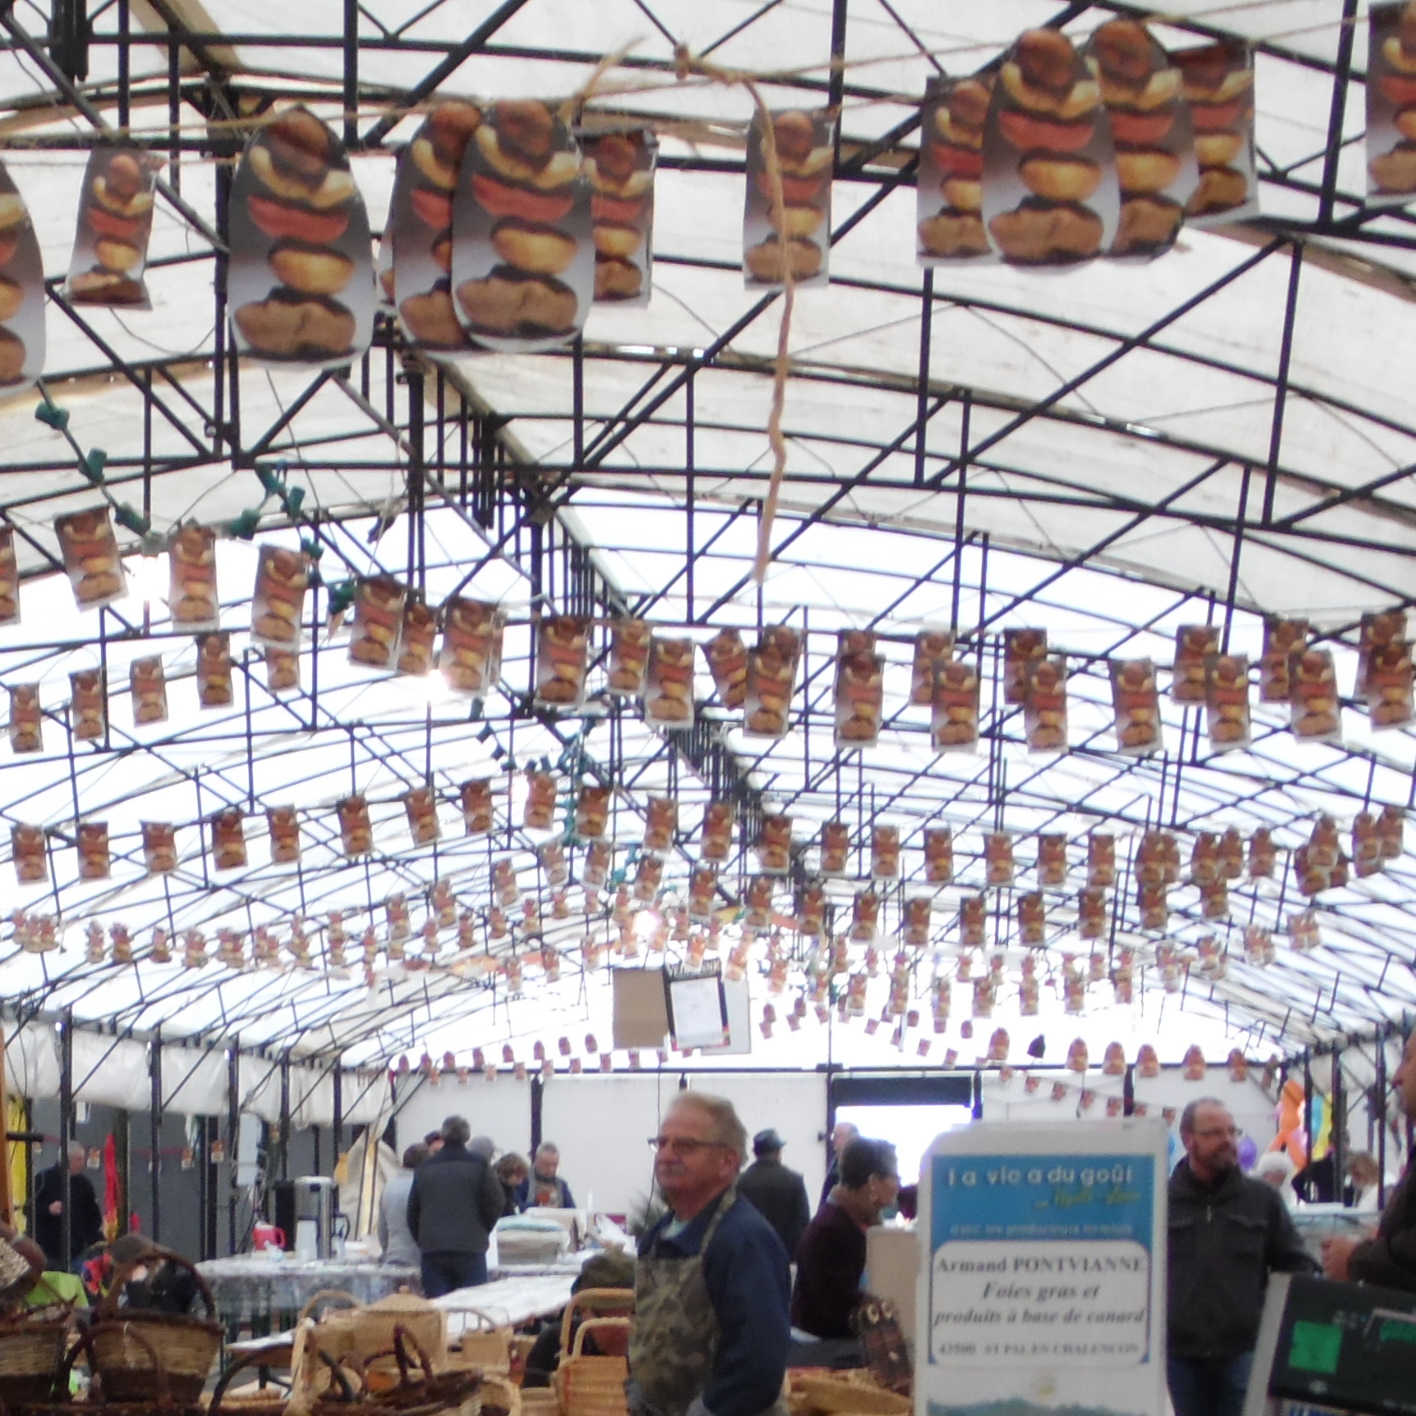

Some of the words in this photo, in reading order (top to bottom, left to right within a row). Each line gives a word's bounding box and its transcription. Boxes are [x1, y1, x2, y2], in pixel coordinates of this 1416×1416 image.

[1028, 1168, 1042, 1184] a
[1048, 1165, 1075, 1184] du
[1080, 1164, 1133, 1187] goût
[937, 1257, 1007, 1273] Armand
[1014, 1256, 1143, 1273] PONTVIANNE
[983, 1280, 1032, 1299] Foies
[1036, 1284, 1077, 1302] gras
[1083, 1282, 1101, 1299] et
[934, 1308, 1002, 1327] produits
[1006, 1309, 1017, 1323] à
[1022, 1307, 1058, 1324] base
[1063, 1307, 1082, 1324] de
[1087, 1308, 1145, 1324] canard
